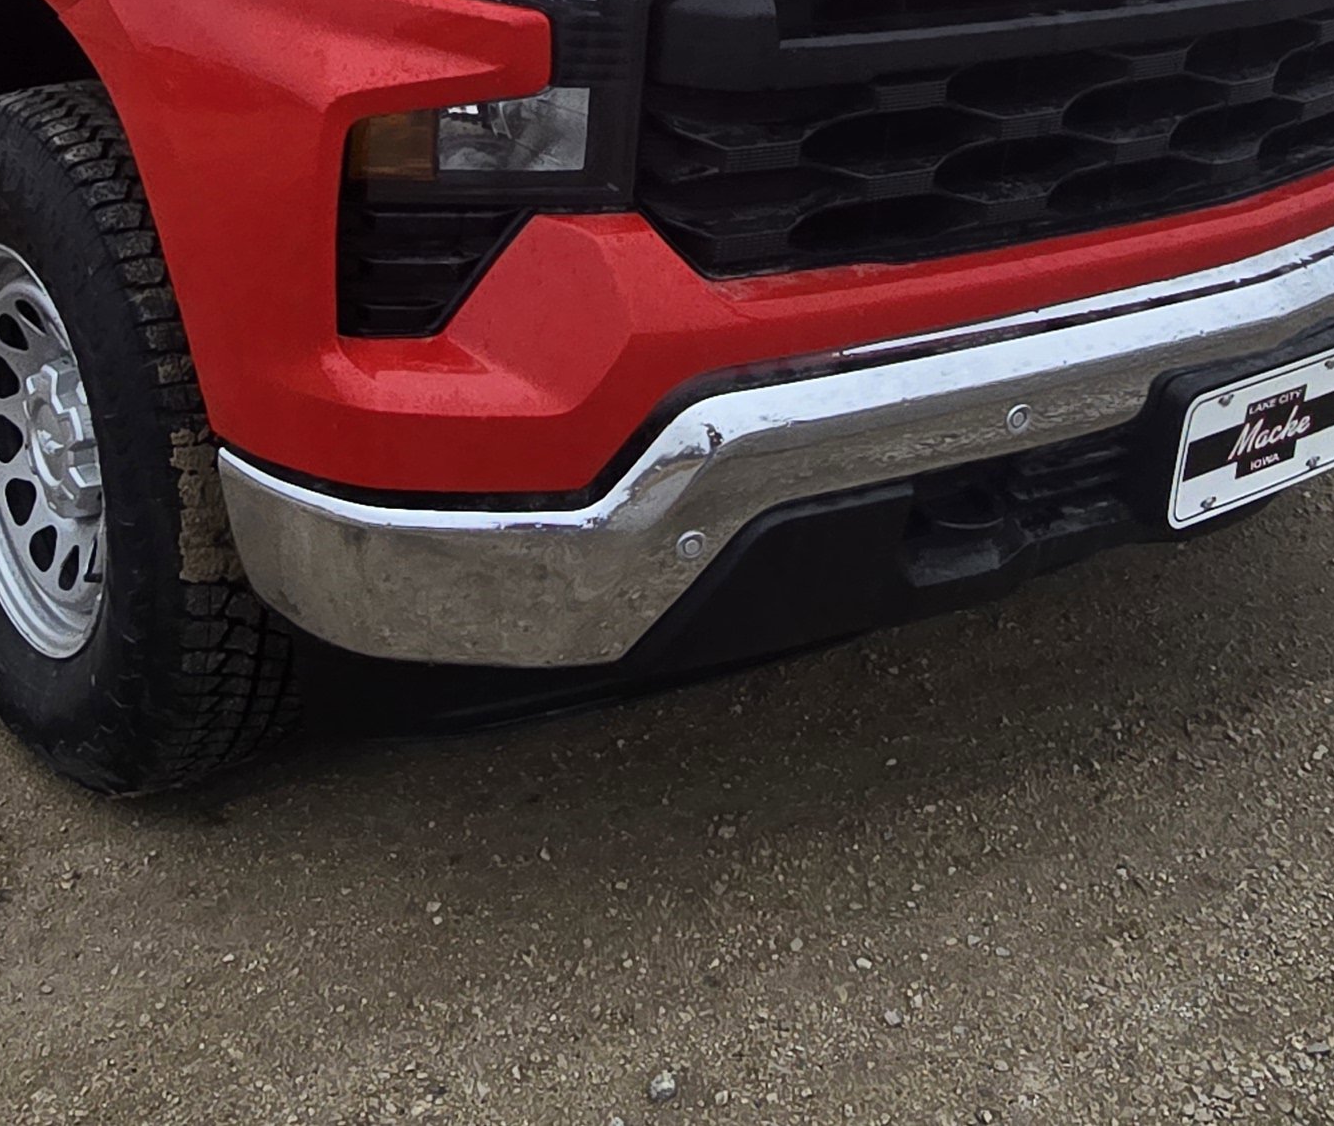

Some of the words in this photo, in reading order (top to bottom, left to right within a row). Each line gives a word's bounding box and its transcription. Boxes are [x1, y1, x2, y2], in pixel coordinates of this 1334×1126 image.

[1248, 398, 1277, 415] LAKE
[1278, 389, 1303, 405] CITY
[1227, 404, 1311, 461] Macke
[1250, 453, 1280, 471] IOWA
